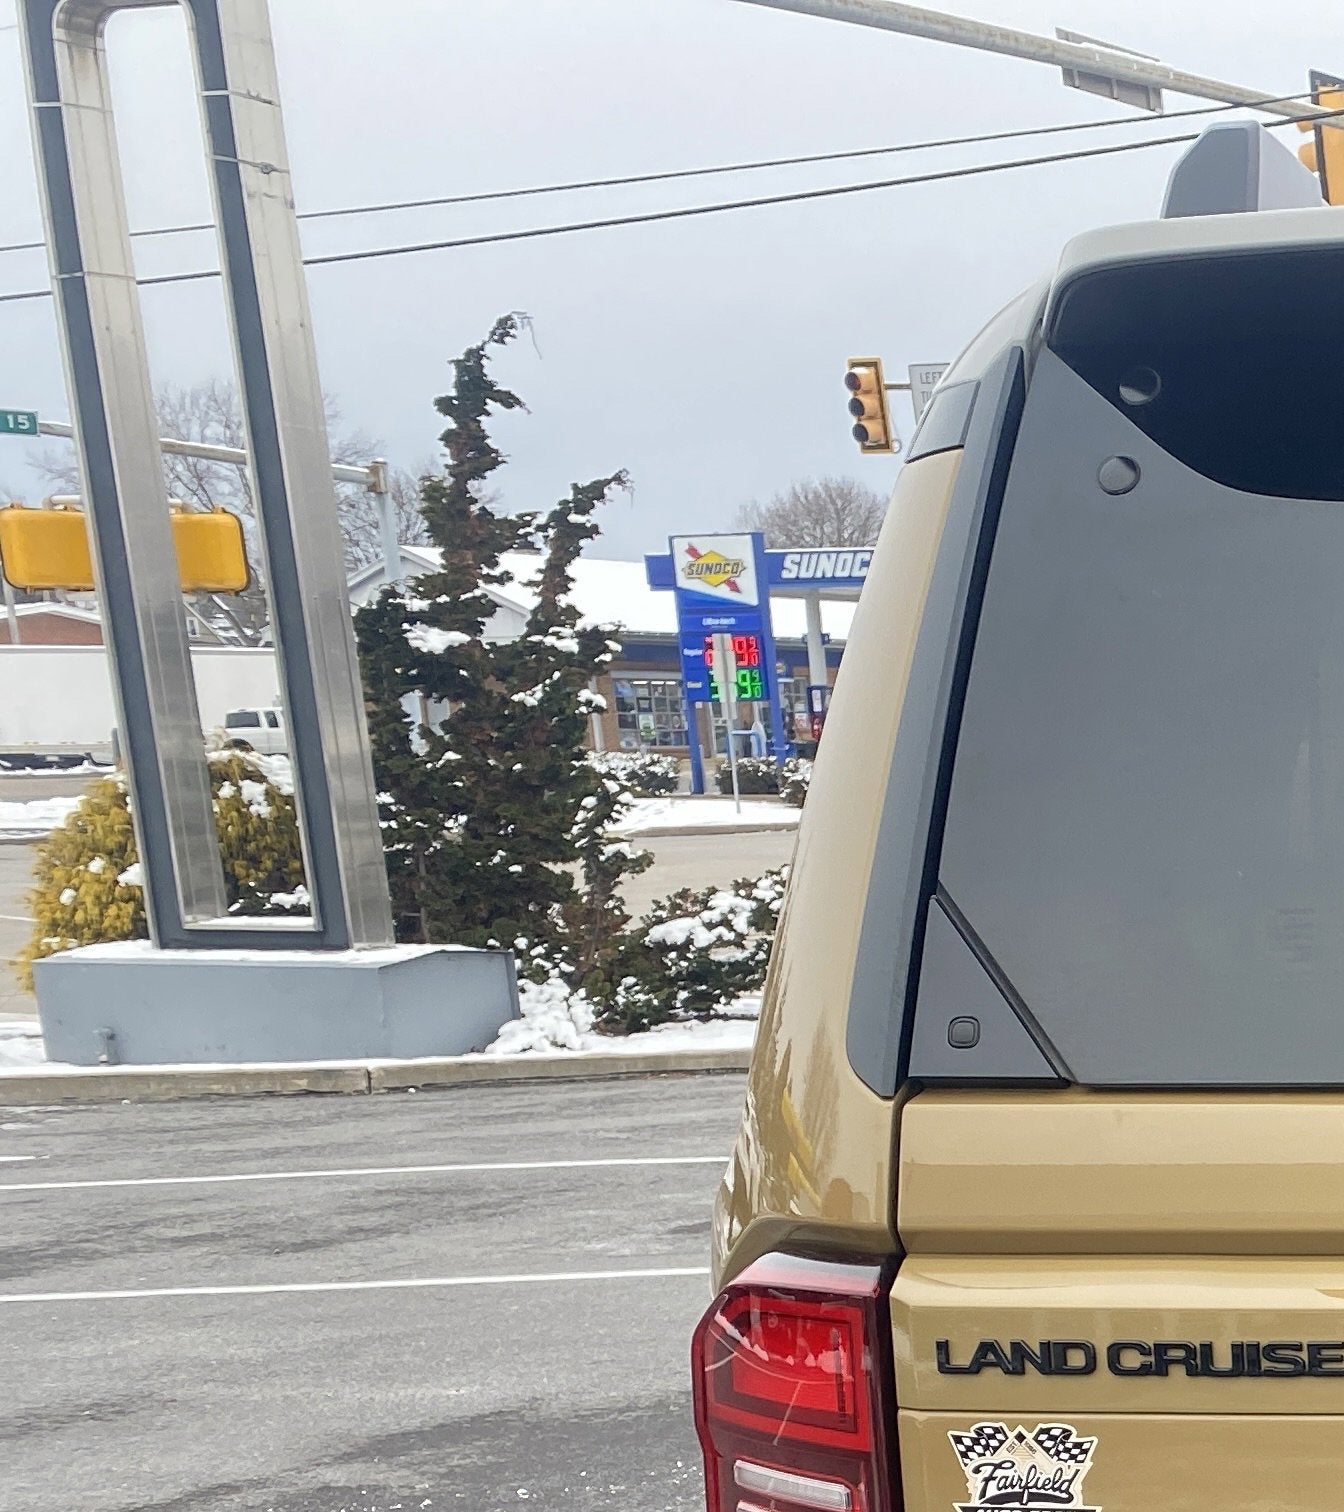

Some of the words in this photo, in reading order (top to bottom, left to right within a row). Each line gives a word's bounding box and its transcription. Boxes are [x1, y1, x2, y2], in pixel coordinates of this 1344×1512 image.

[7, 414, 30, 430] 15
[687, 562, 740, 576] SUNOCO
[781, 552, 871, 579] SUNOC
[936, 1338, 1097, 1376] LAND
[972, 1459, 1081, 1502] Fairfield
